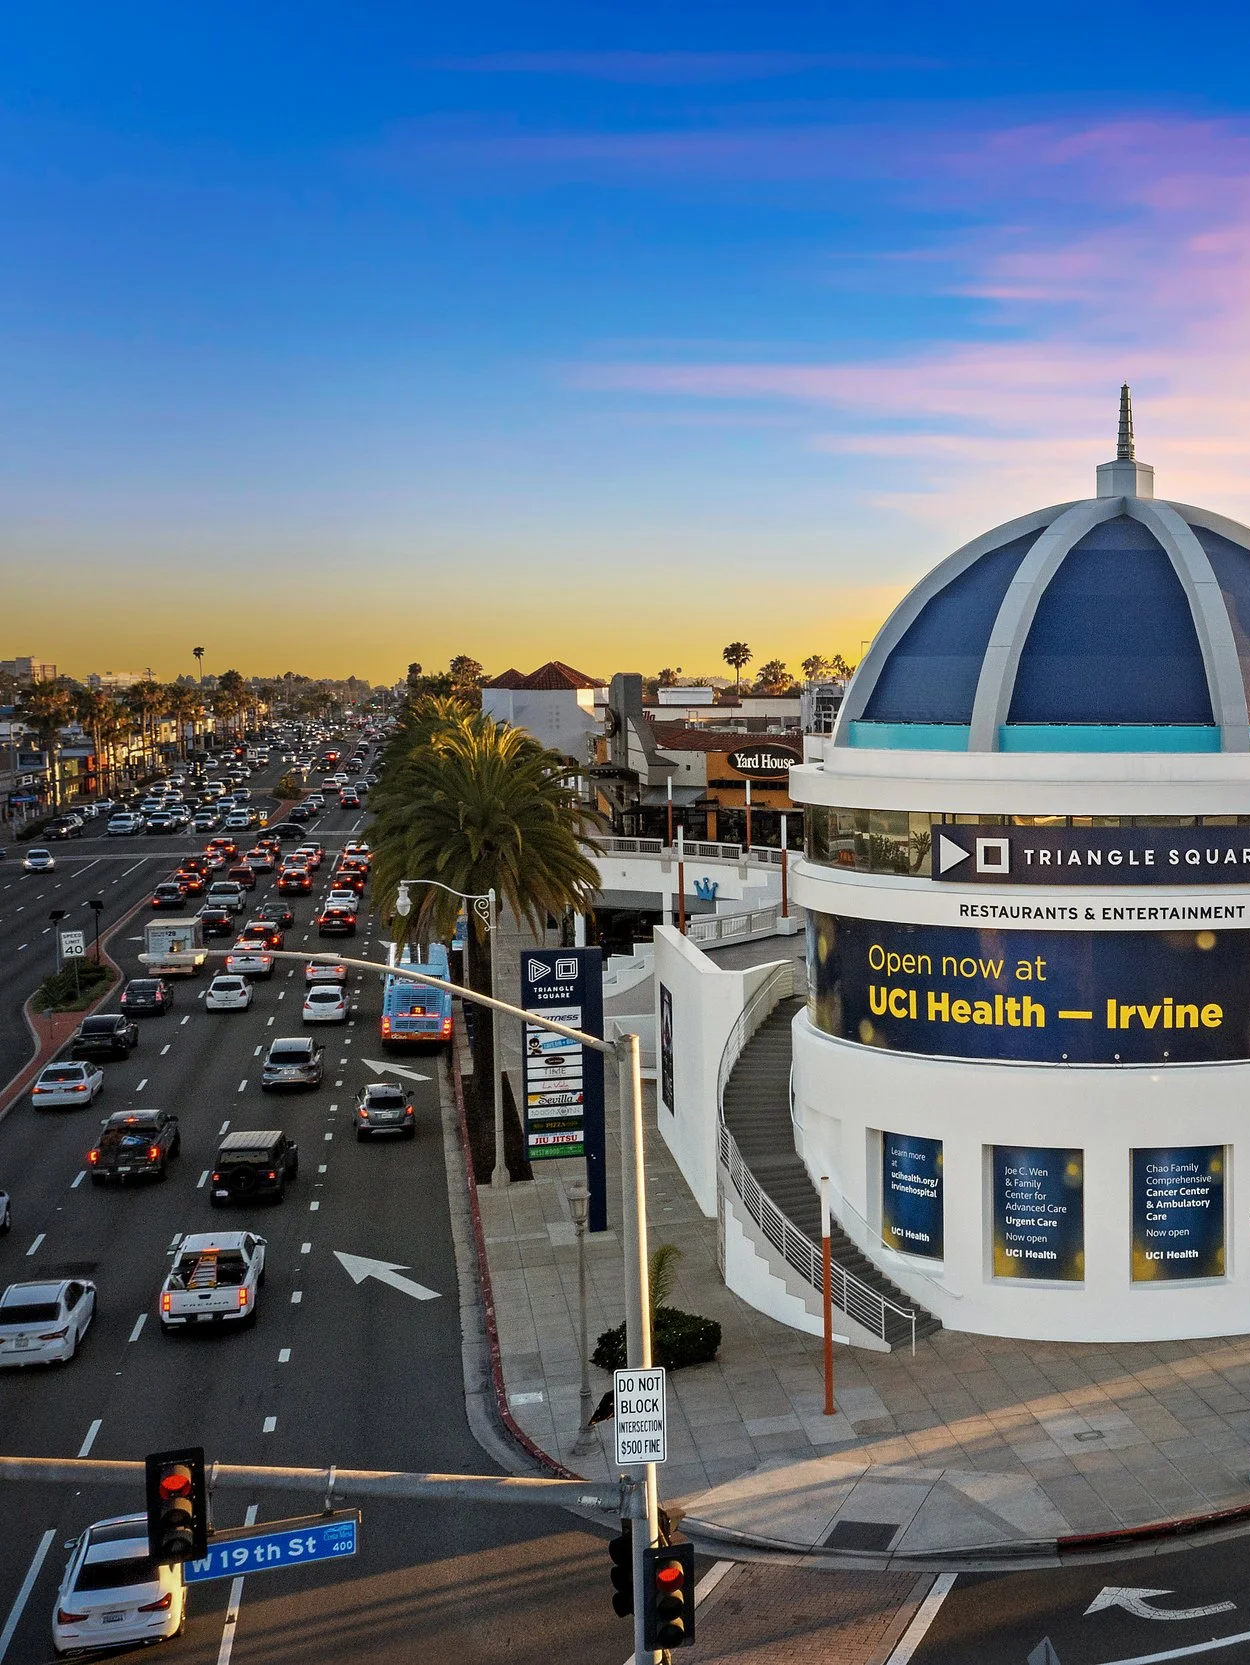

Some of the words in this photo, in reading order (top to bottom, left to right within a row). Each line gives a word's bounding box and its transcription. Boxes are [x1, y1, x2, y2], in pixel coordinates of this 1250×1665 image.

[734, 753, 759, 769] Yard
[762, 753, 795, 769] House
[1024, 849, 1156, 866] TRIANGLE
[959, 904, 1078, 920] RESTAURANTS
[1084, 907, 1096, 920] &
[1101, 905, 1246, 921] ENTERTAINMENT
[65, 946, 83, 954] 40
[868, 943, 932, 977] Open
[941, 955, 1004, 979] now
[1015, 955, 1047, 981] at
[533, 985, 574, 993] TRIANGLE
[868, 985, 917, 1020] UCI
[927, 991, 1045, 1028] Health
[1106, 997, 1224, 1029] Irvine
[538, 1095, 573, 1104] Sevilla
[553, 1135, 577, 1143] JITSU
[891, 1147, 907, 1159] Learn
[908, 1153, 926, 1161] more
[1004, 1166, 1018, 1176] Joe
[1019, 1167, 1028, 1176] C.
[1029, 1168, 1048, 1177] Wen
[1146, 1164, 1169, 1173] Chao
[1171, 1163, 1199, 1174] Family
[891, 1171, 938, 1188] ucihealth.org/
[1005, 1178, 1013, 1187] &
[1014, 1179, 1042, 1189] Family
[1146, 1174, 1212, 1186] Comprehensive
[891, 1181, 937, 1198] irvinehospital
[1005, 1190, 1032, 1200] Center
[1034, 1191, 1046, 1200] for
[1146, 1188, 1178, 1197] Cancer
[1179, 1187, 1209, 1196] Center
[1005, 1202, 1045, 1213] Advanced
[1047, 1205, 1067, 1213] Care
[1146, 1200, 1154, 1209] &
[1156, 1199, 1210, 1210] Ambulatory
[1005, 1216, 1035, 1228] Urgent
[1037, 1218, 1057, 1227] Care
[1146, 1212, 1167, 1221] Care
[891, 1226, 903, 1236] UCI
[905, 1230, 930, 1242] Health
[1005, 1233, 1025, 1241] Now
[1027, 1235, 1047, 1244] open
[1146, 1228, 1166, 1237] Now
[1168, 1228, 1189, 1238] open
[1005, 1249, 1022, 1257] UCI
[1025, 1249, 1057, 1259] Health
[1146, 1251, 1163, 1260] UCI
[1166, 1249, 1199, 1259] Health
[619, 1378, 634, 1392] DO
[639, 1377, 661, 1391] NOT
[621, 1398, 659, 1414] BLOCK
[618, 1420, 663, 1434] INTERSECTION
[621, 1440, 642, 1454] $500
[645, 1439, 661, 1453] FINE
[333, 1540, 353, 1552] 400
[192, 1552, 212, 1573] W
[220, 1543, 280, 1569] 19th
[288, 1536, 317, 1557] St
